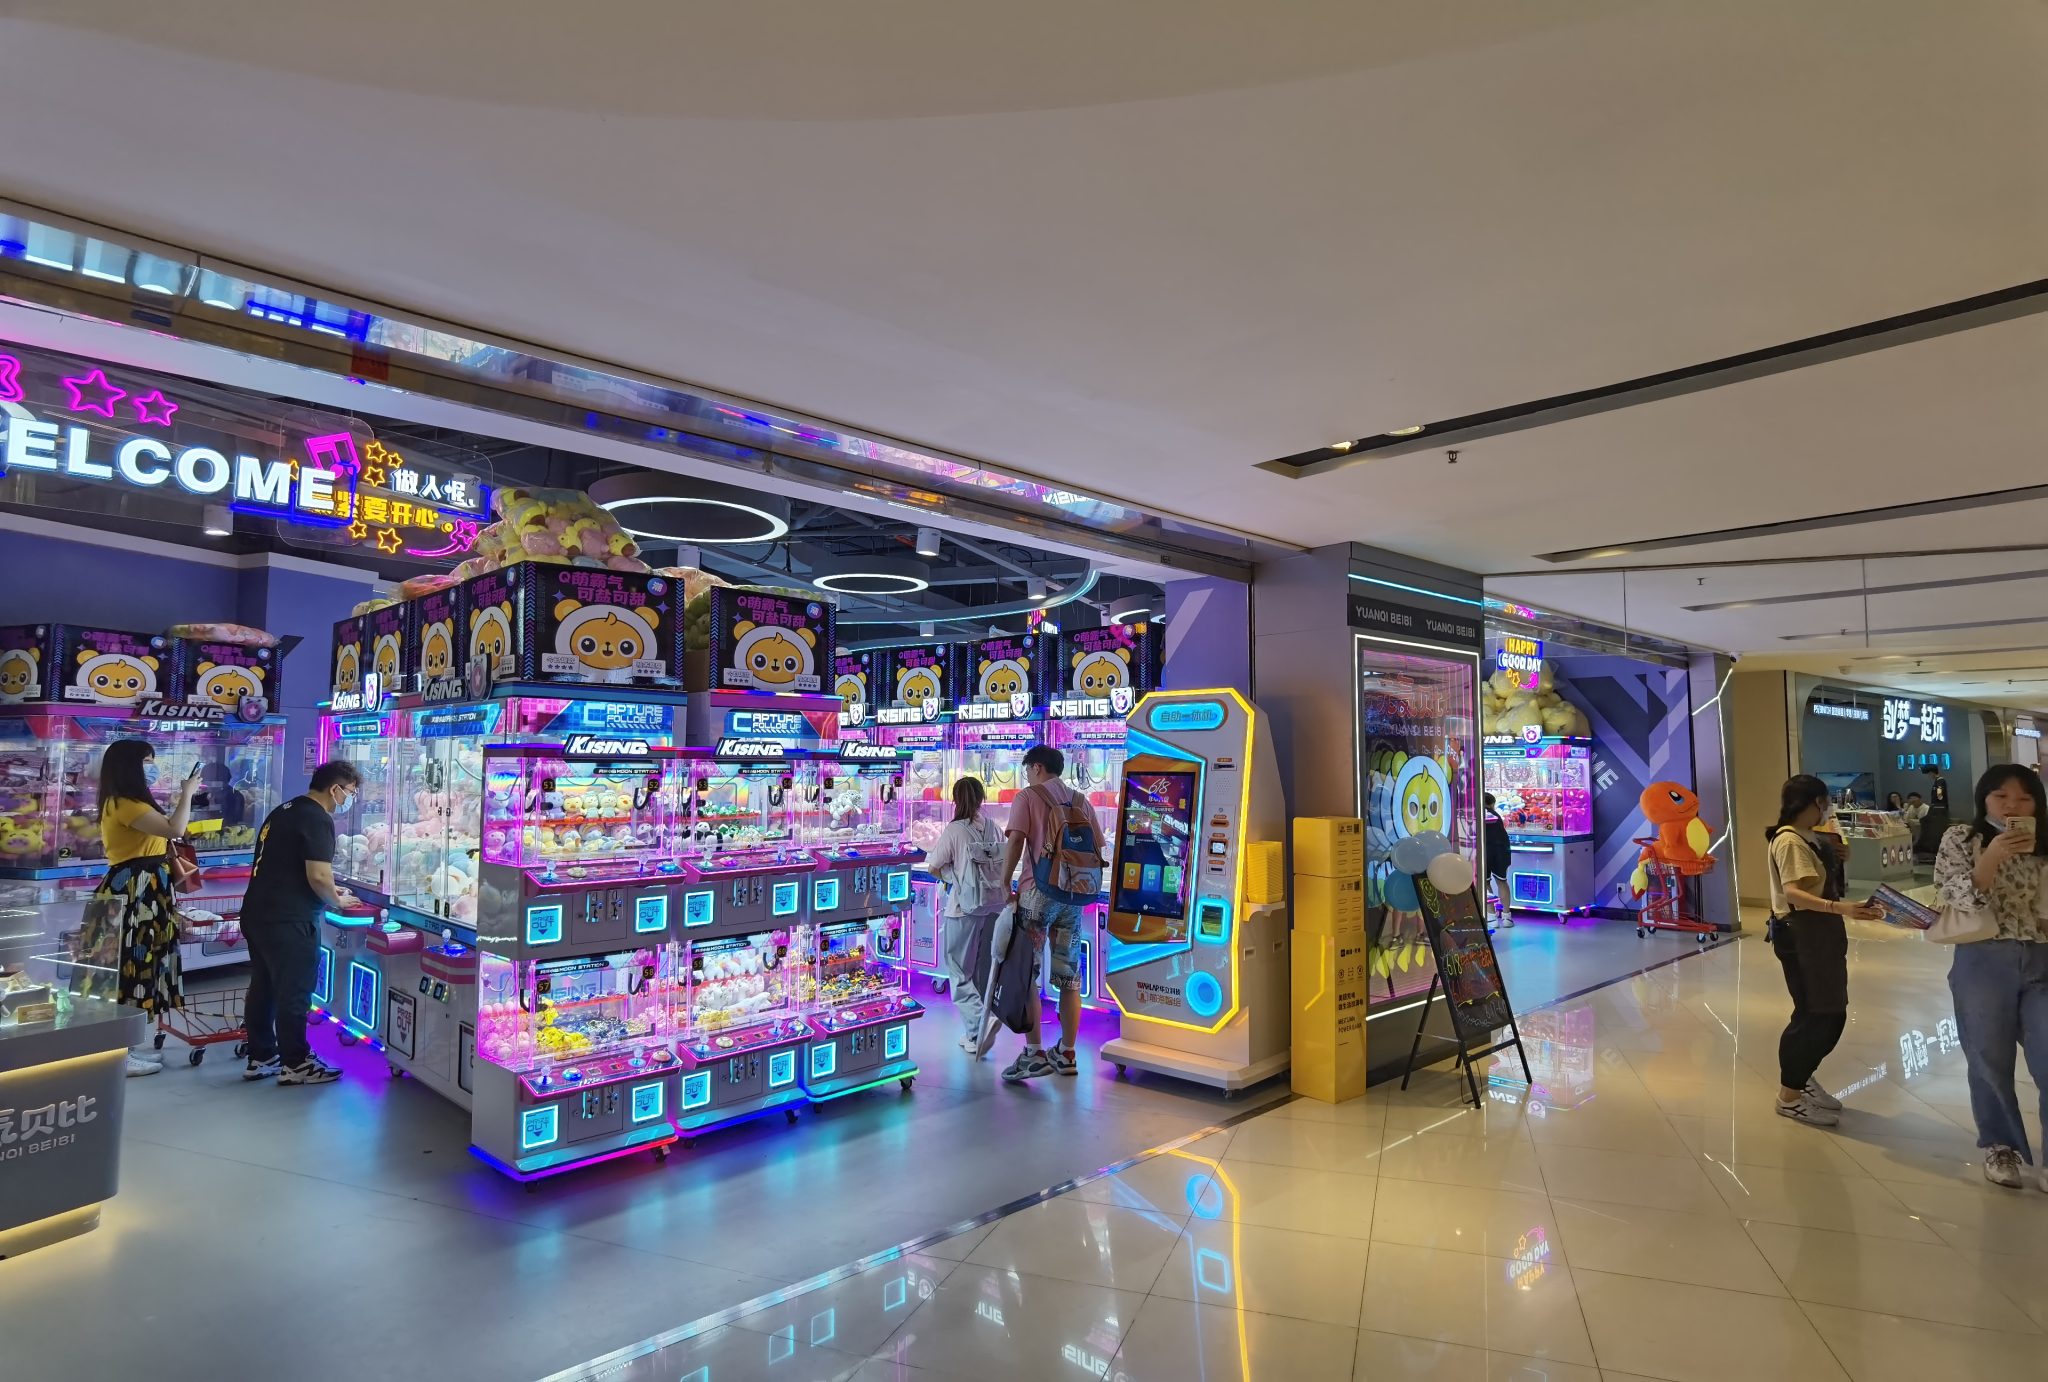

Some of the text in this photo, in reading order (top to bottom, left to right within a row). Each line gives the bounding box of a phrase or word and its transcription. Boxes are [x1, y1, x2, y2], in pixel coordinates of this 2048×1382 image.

[0, 414, 337, 511] ELCOME
[1356, 605, 1389, 622] YUANQI
[1507, 638, 1537, 656] HAPPY
[140, 702, 225, 720] KISING
[1883, 699, 1945, 742] 创梦一起玩
[570, 735, 649, 755] KISING
[721, 738, 784, 756] KISING
[843, 741, 897, 758] KISING
[60, 848, 69, 857] 2
[531, 920, 555, 929] OUT
[28, 1133, 75, 1154] BEIBI
